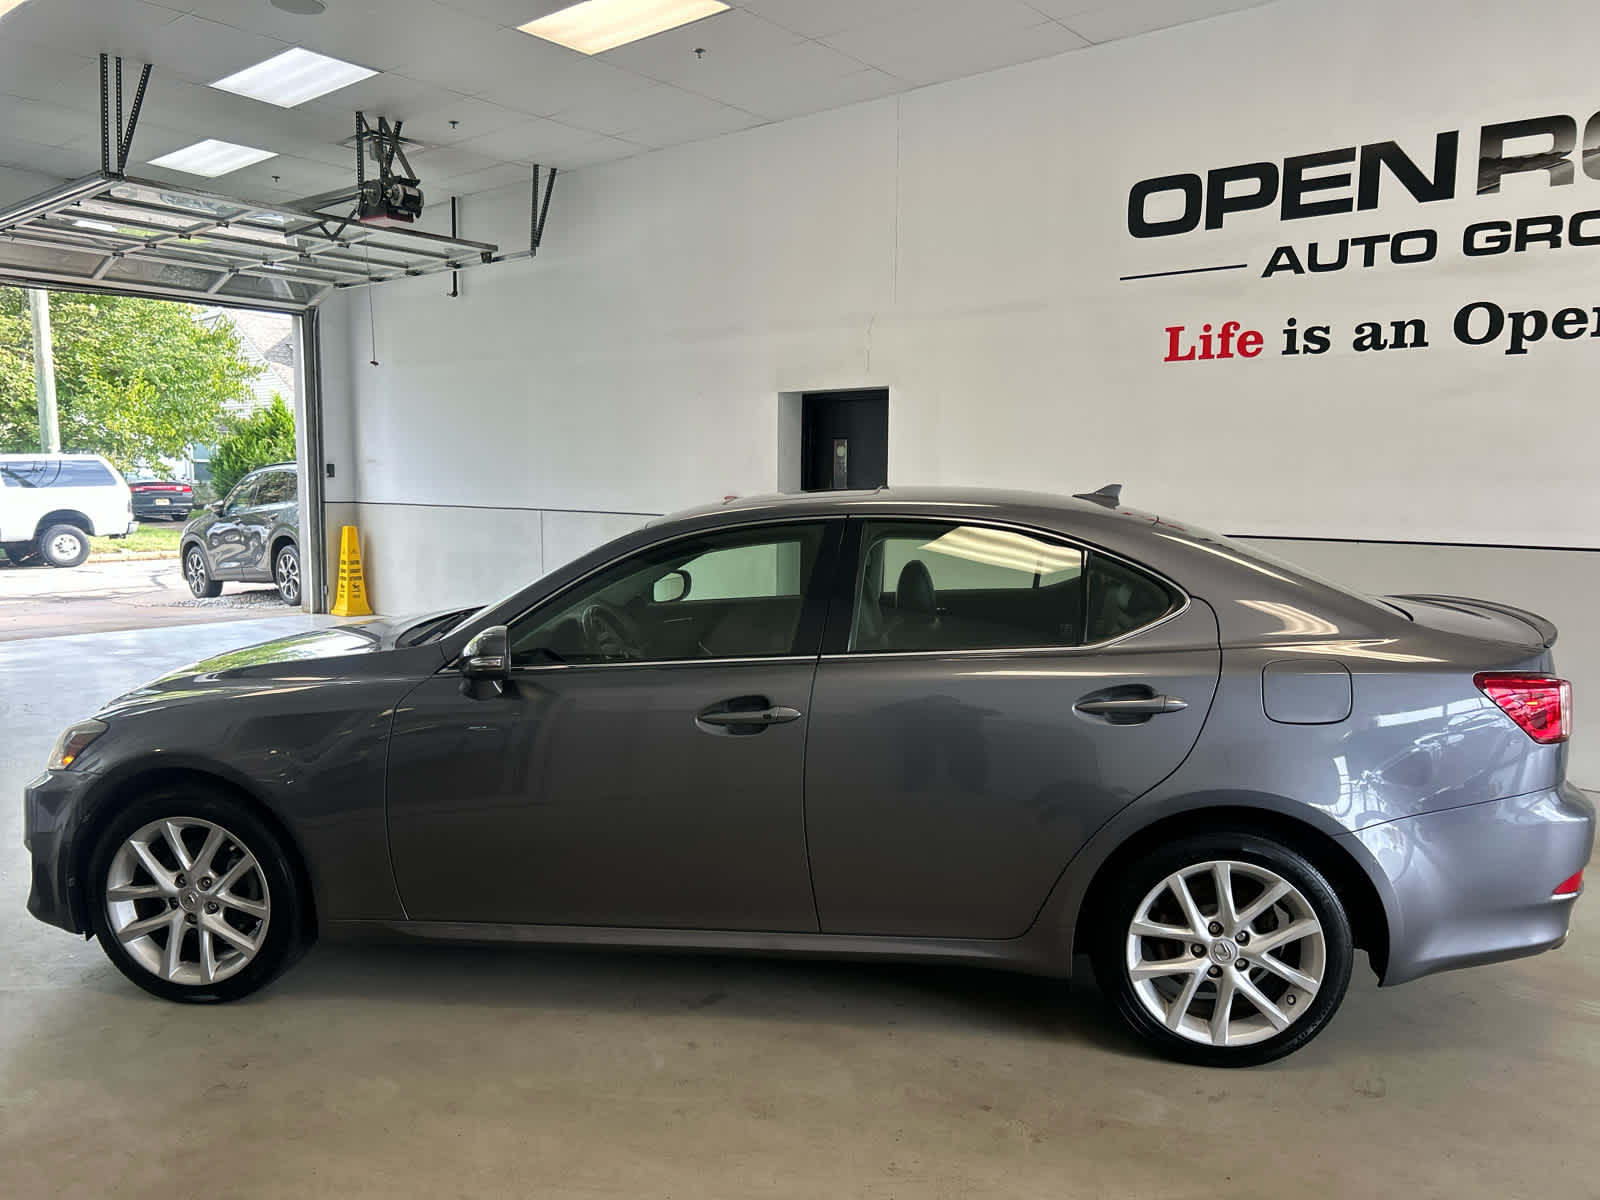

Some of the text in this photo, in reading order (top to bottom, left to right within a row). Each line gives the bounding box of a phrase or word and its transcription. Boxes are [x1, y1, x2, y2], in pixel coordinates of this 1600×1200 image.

[1127, 109, 1600, 239] OPEN R
[1260, 228, 1438, 279] AUTO
[1163, 301, 1600, 363] Life is an Ope
